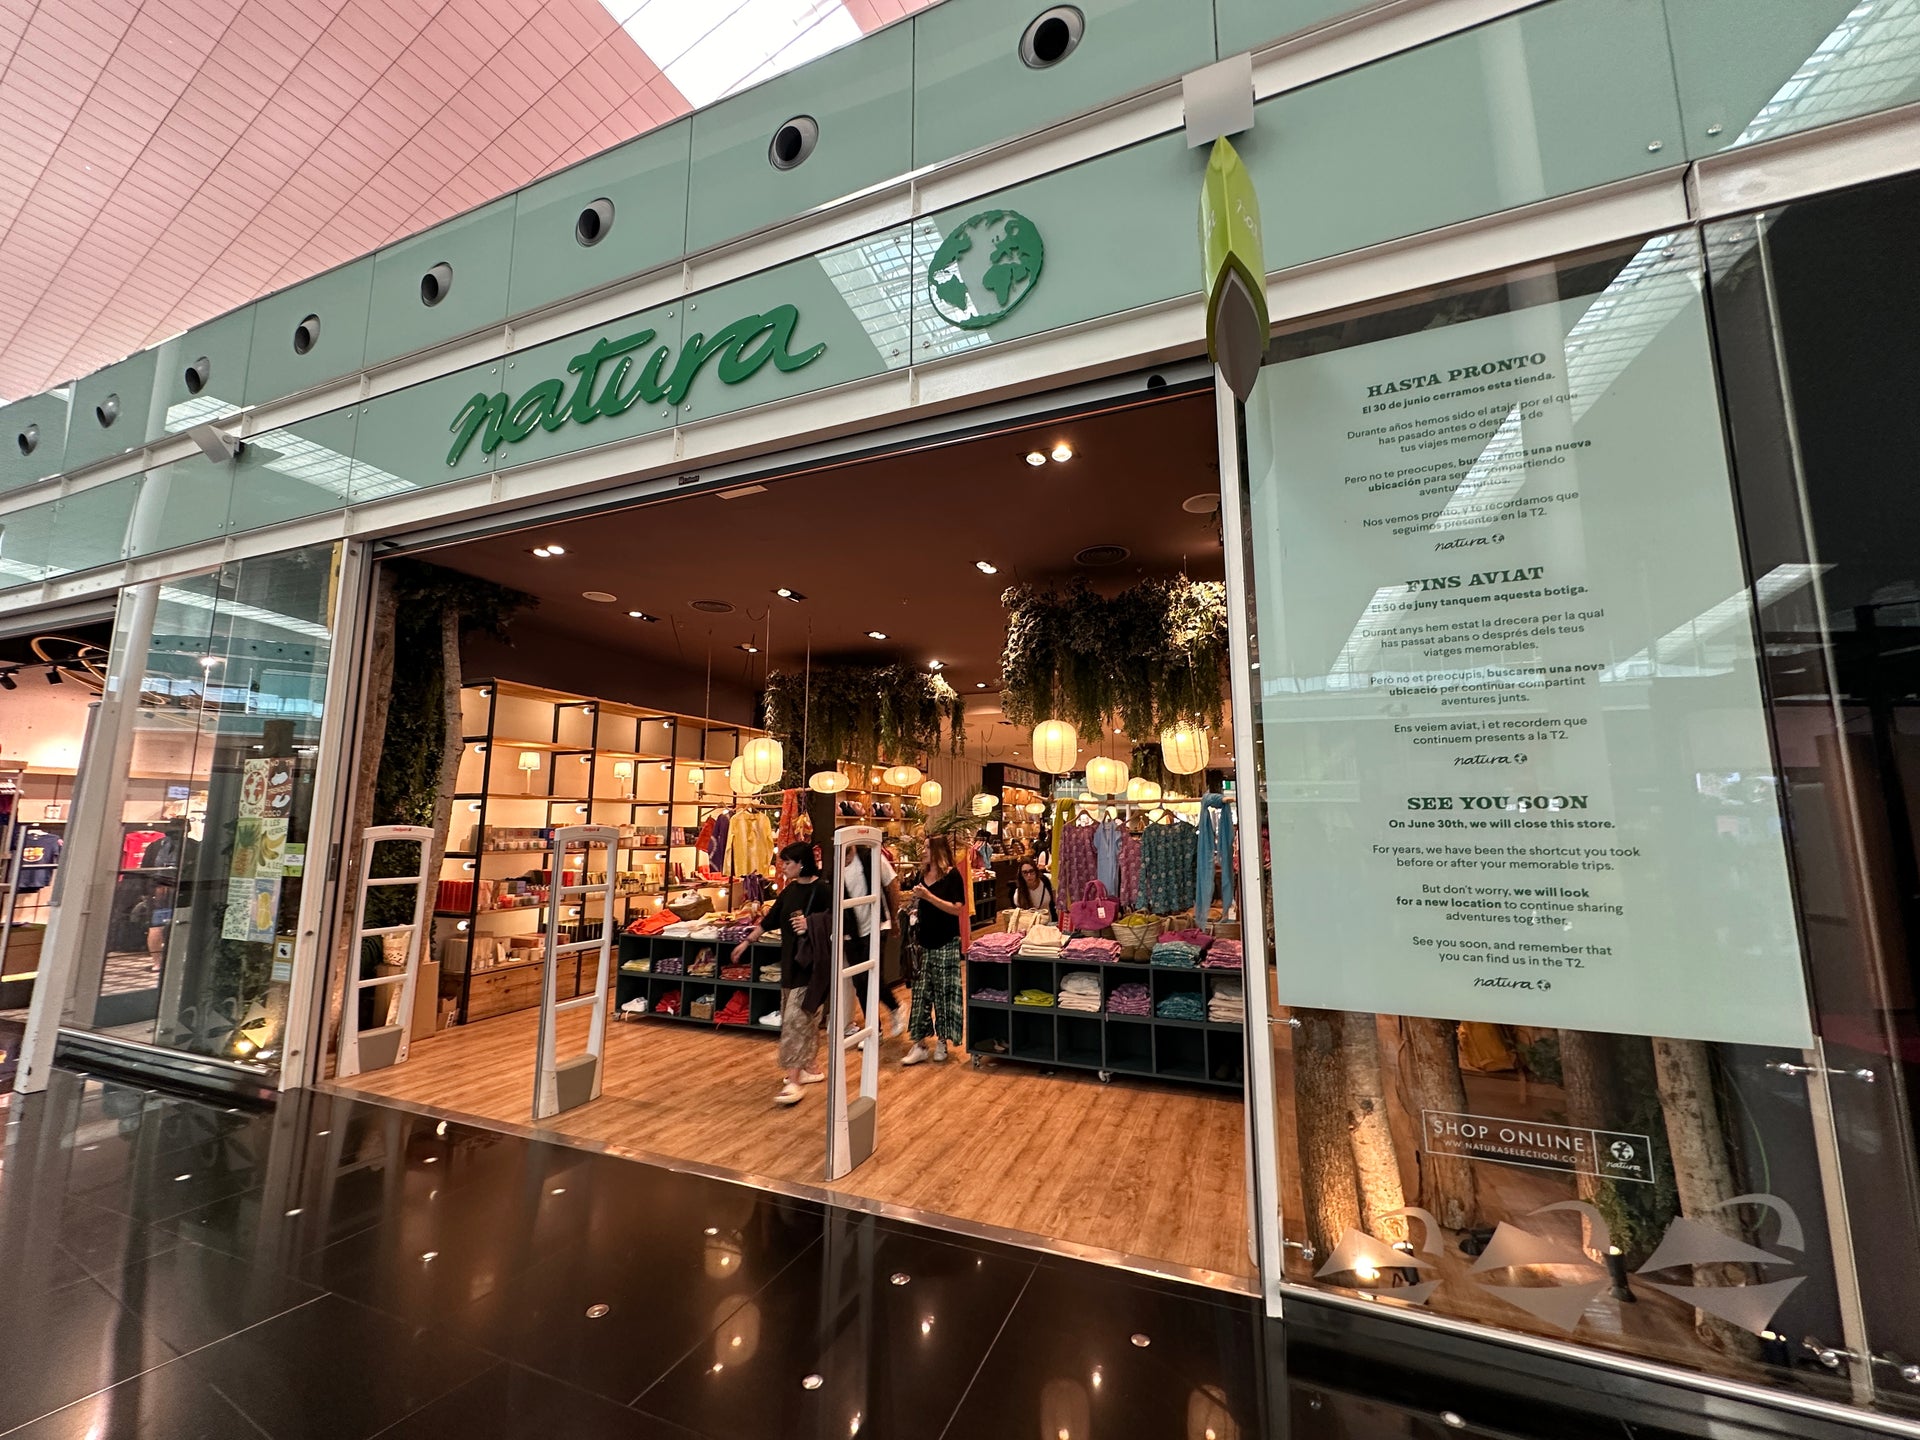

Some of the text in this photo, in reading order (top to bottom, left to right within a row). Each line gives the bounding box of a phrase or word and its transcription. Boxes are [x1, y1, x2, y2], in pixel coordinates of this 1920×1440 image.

[445, 302, 826, 467] natura
[1367, 353, 1546, 398] HASTA PRONTO
[1362, 373, 1555, 414] El 30 de junio cerramos esta tienda.
[1347, 392, 1578, 440] Durante años hemos sido el por el que
[1379, 409, 1543, 445] has pasado antes de
[1401, 438, 1448, 453] tus viajes
[1344, 440, 1591, 484] Pero no preocupes, una nueva
[1368, 455, 1565, 492] ubicación para compartiendo
[1363, 491, 1579, 527] Nos vemos pronto, recordamos que
[1392, 523, 1442, 536] seguimos
[1444, 515, 1498, 529] presentes
[1529, 508, 1547, 517] T2.
[1434, 537, 1489, 551] natura
[1406, 567, 1544, 593] FINS AVIAT
[1383, 584, 1588, 612] 30 de juny tanquem aquesta botiga.
[1362, 609, 1604, 638] Durant anys hem estat la drecera per la qual
[1381, 625, 1584, 649] has passat abans després dels teus
[1424, 641, 1539, 658] viatges memorables.
[1371, 663, 1605, 685] Però no et preocupis, buscarem una nova
[1389, 677, 1585, 696] ubicació per continuar compartint
[1441, 693, 1529, 706] aventures junts.
[1394, 717, 1587, 733] Ens veiem aviat, et recordem que
[1413, 731, 1568, 745] continuem presents la T2.
[1454, 755, 1512, 766] natura
[1408, 795, 1588, 810] SEE YOU SOON
[1389, 819, 1615, 830] On June 30th, we will close this store.
[1373, 845, 1640, 858] For years, we have been the shortcut you took
[1397, 858, 1614, 872] before after your memorable trips.
[1422, 884, 1589, 898] But don't worry, we will look
[1397, 897, 1623, 915] for new location to continue sharing
[1446, 912, 1568, 926] adventures together.
[1413, 936, 1612, 956] See you soon, and remember that
[1439, 952, 1584, 968] you can find the T2.
[1474, 977, 1533, 990] natura
[1434, 1120, 1584, 1151] SHOP ONLINE
[1606, 1161, 1642, 1172] natura
